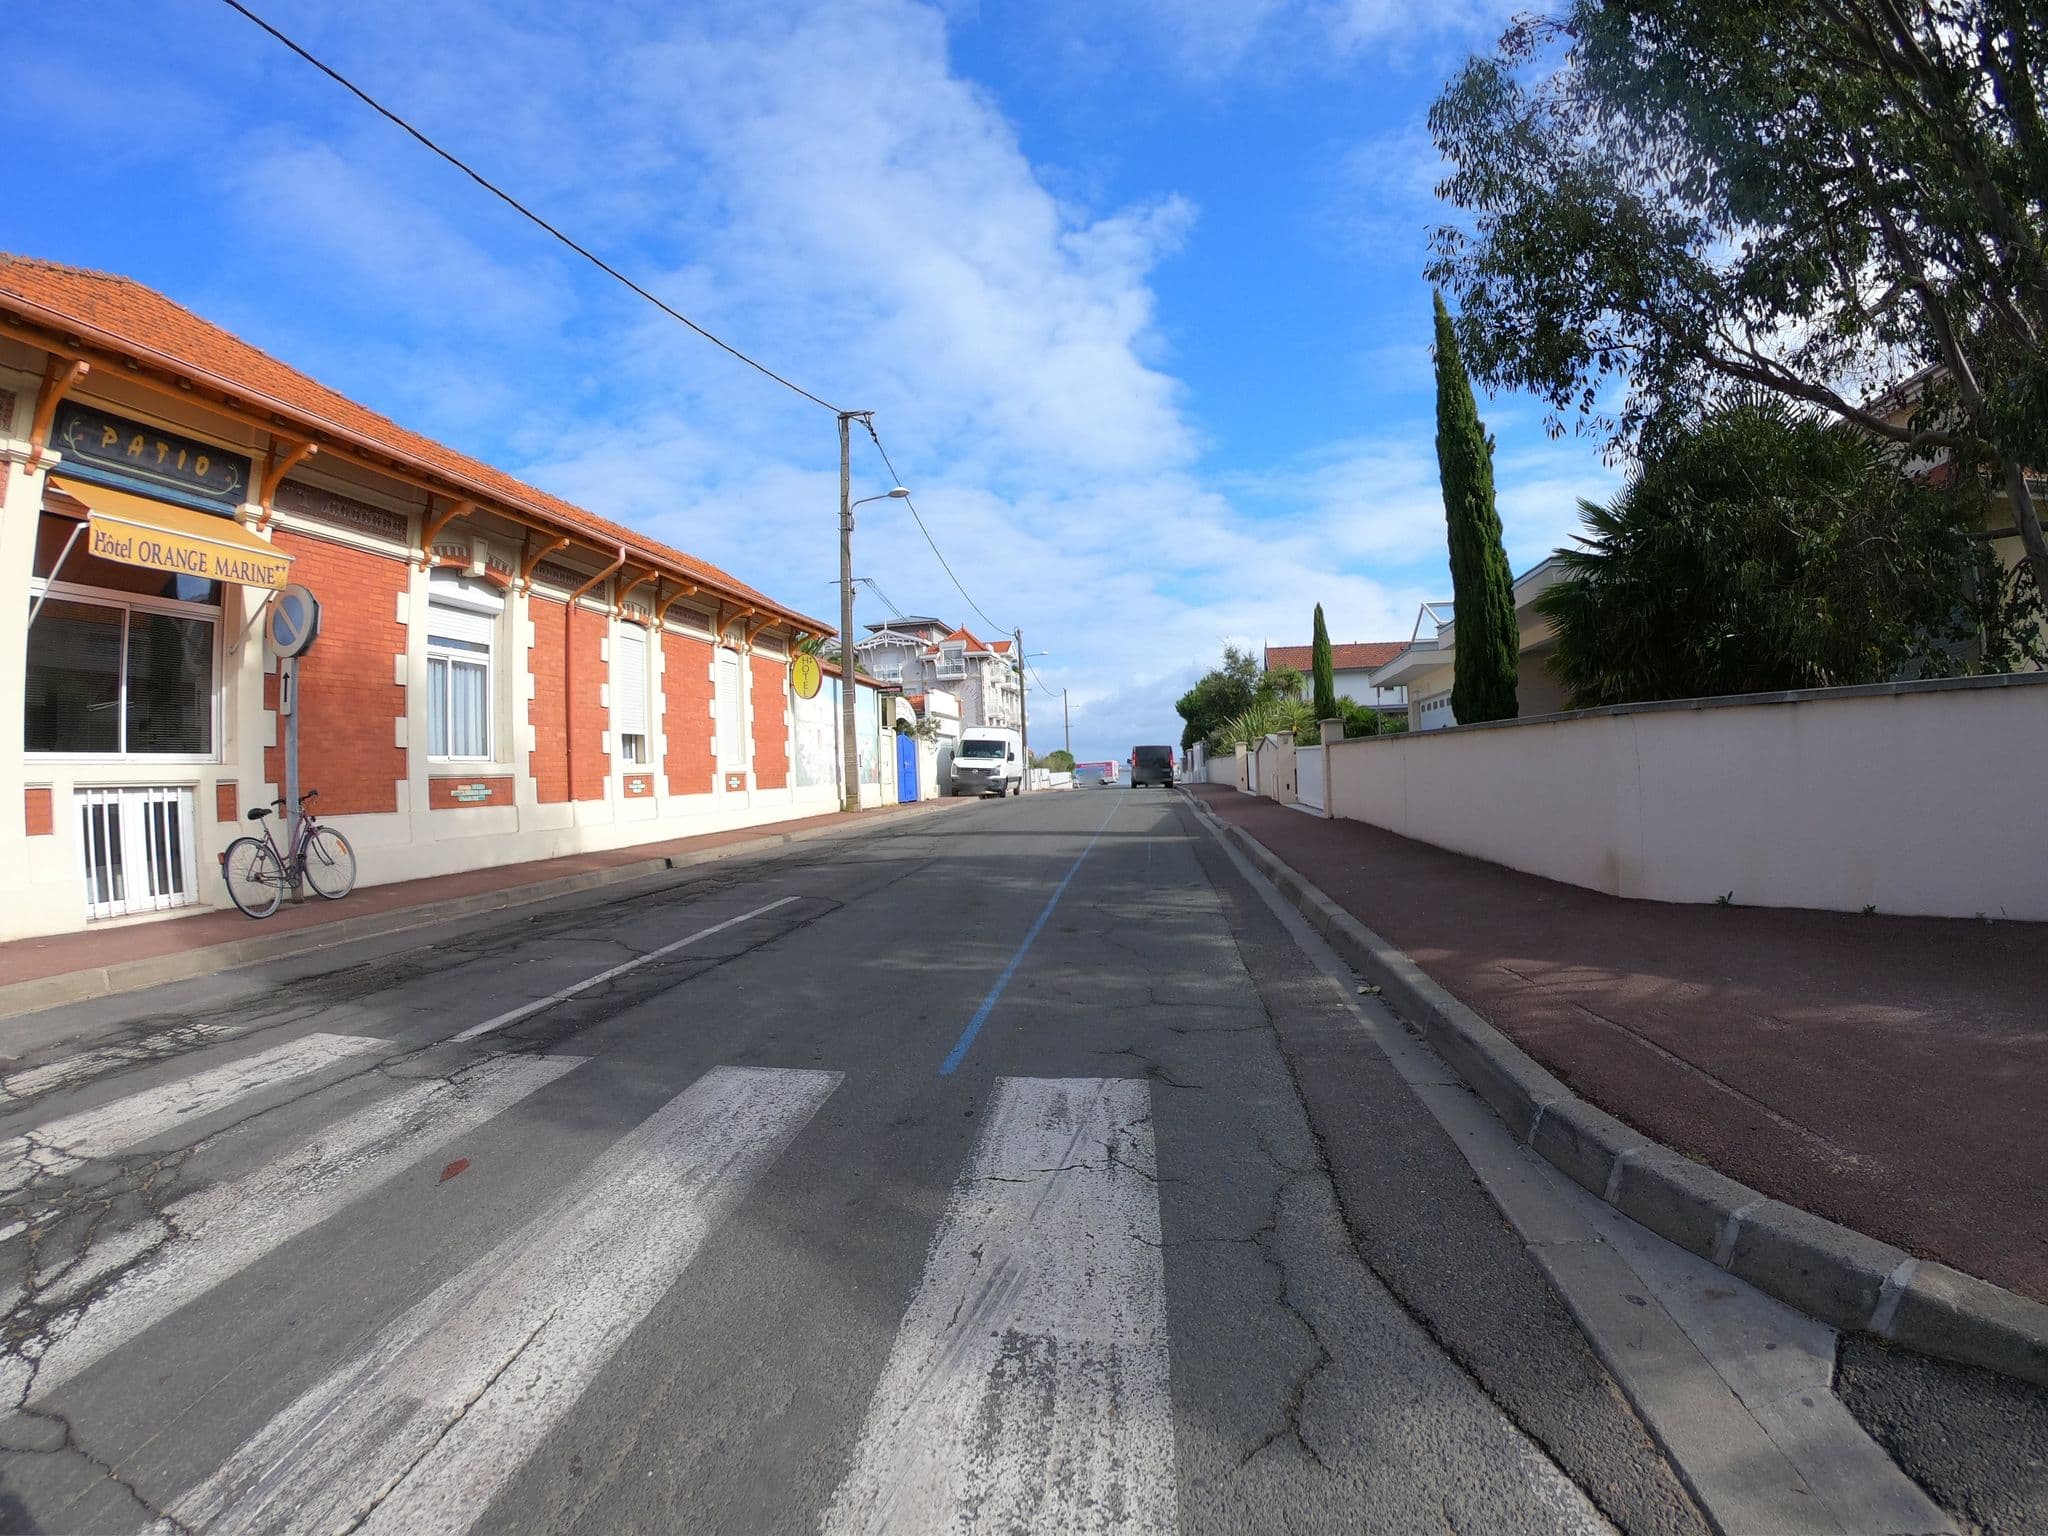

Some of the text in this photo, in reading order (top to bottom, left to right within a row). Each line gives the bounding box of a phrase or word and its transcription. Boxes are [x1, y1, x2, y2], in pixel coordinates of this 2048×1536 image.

[102, 424, 210, 477] PATIO
[94, 530, 132, 559] Hôtel
[138, 541, 208, 573] ORANGE
[802, 656, 810, 698] HOTEL
